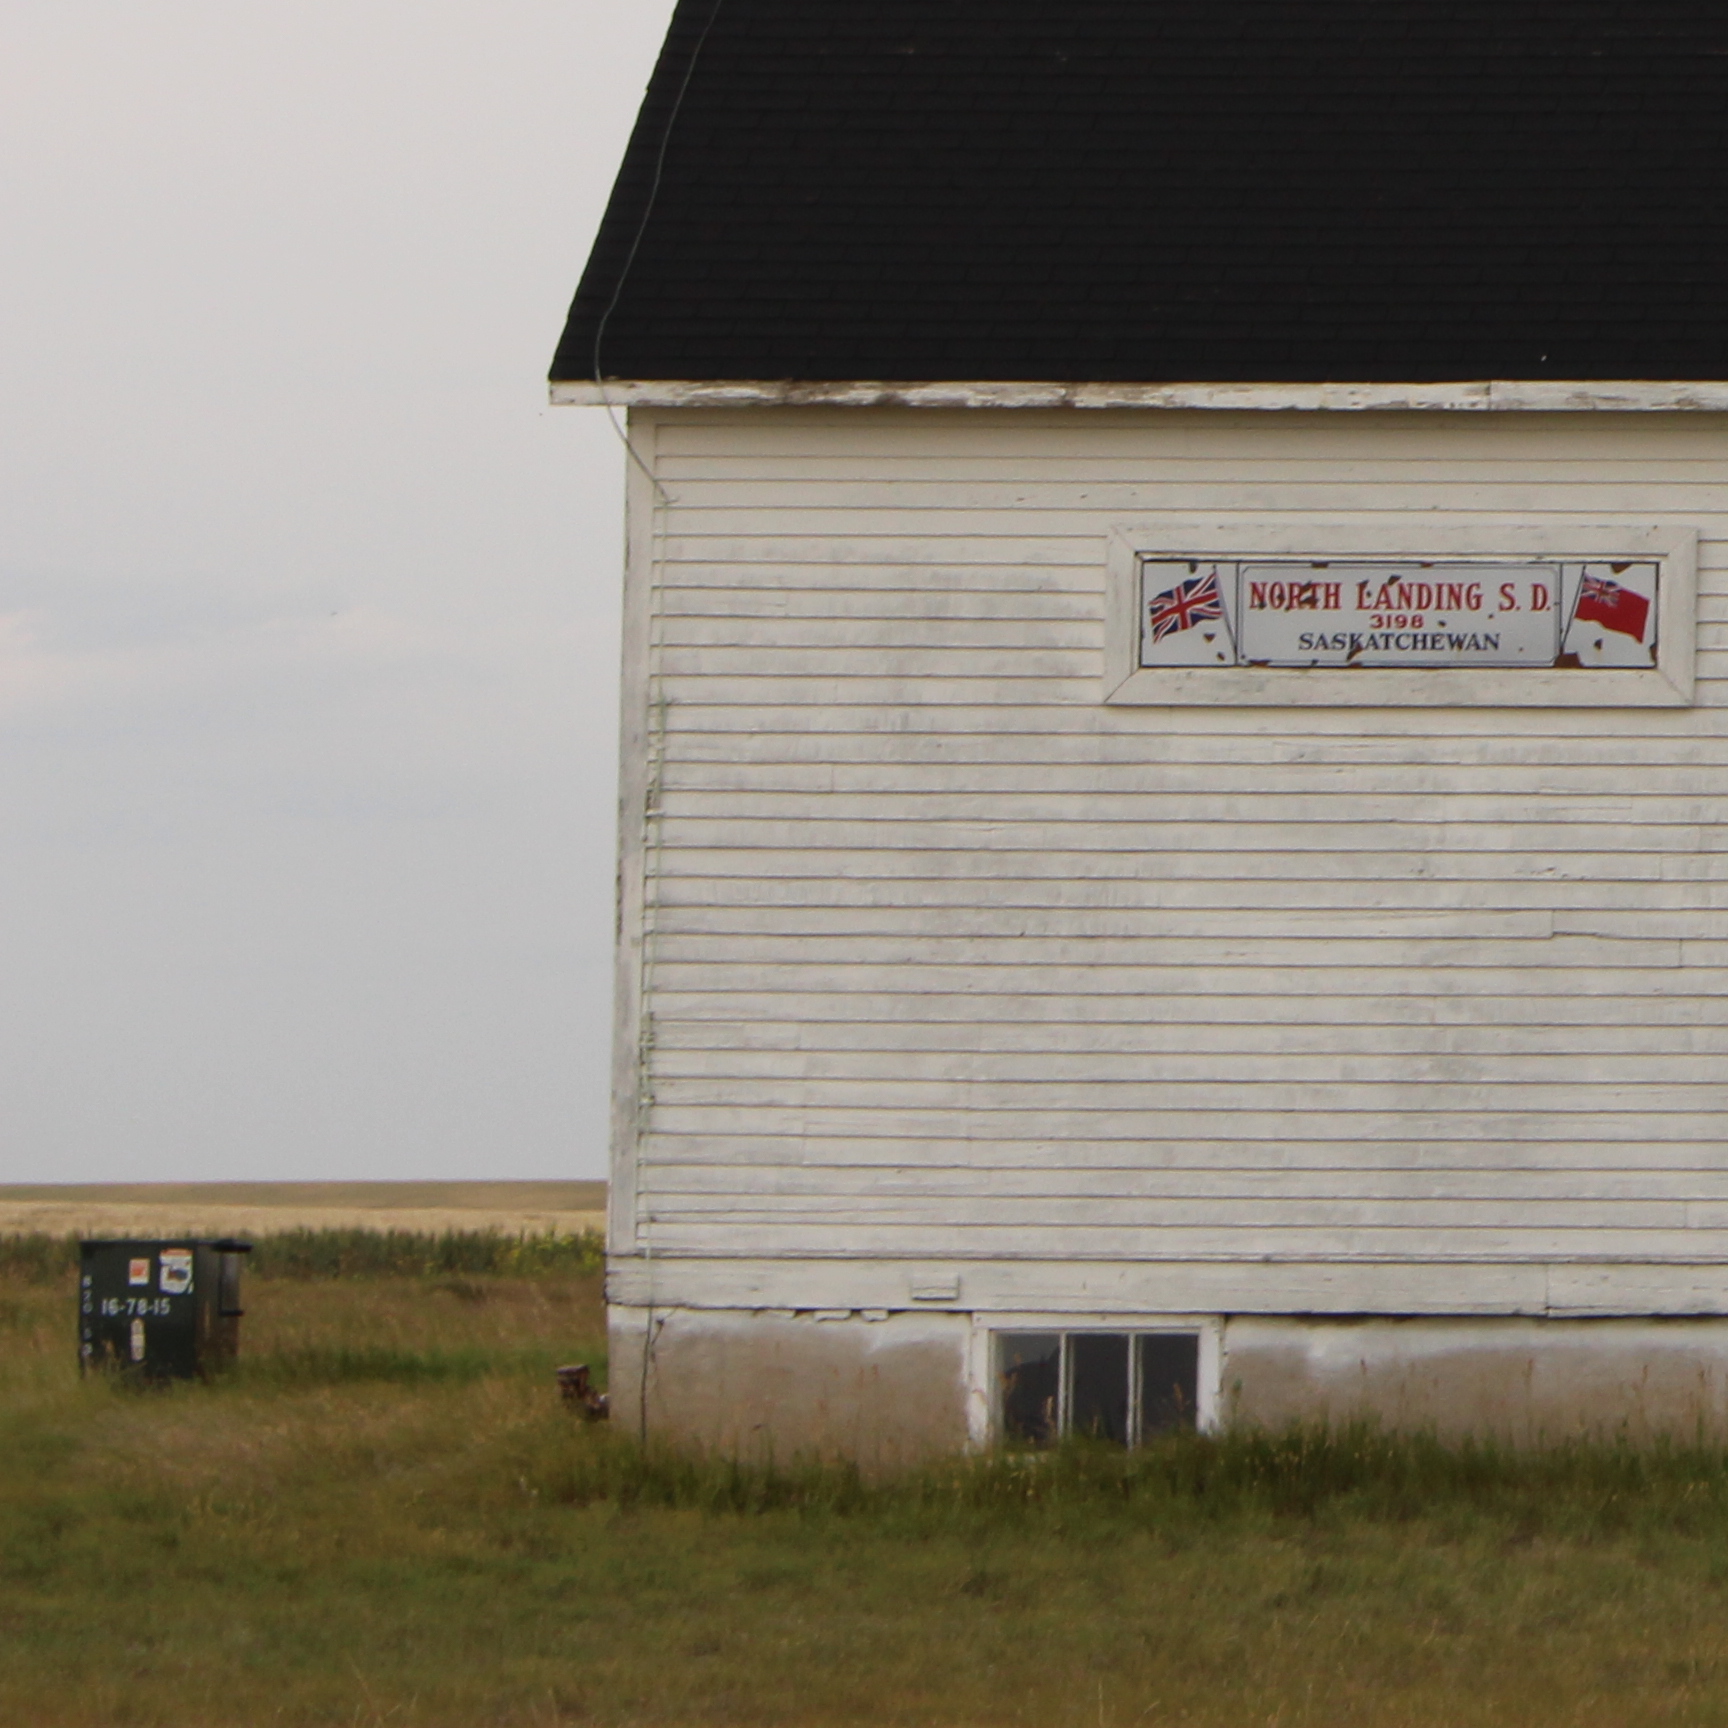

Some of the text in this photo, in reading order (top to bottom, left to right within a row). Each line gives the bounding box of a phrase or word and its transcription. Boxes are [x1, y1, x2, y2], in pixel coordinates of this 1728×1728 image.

[1249, 582, 1551, 612] NORTH LANDING S. D.
[1369, 614, 1424, 629] 3198
[1298, 632, 1501, 651] SASKATCHEWAN
